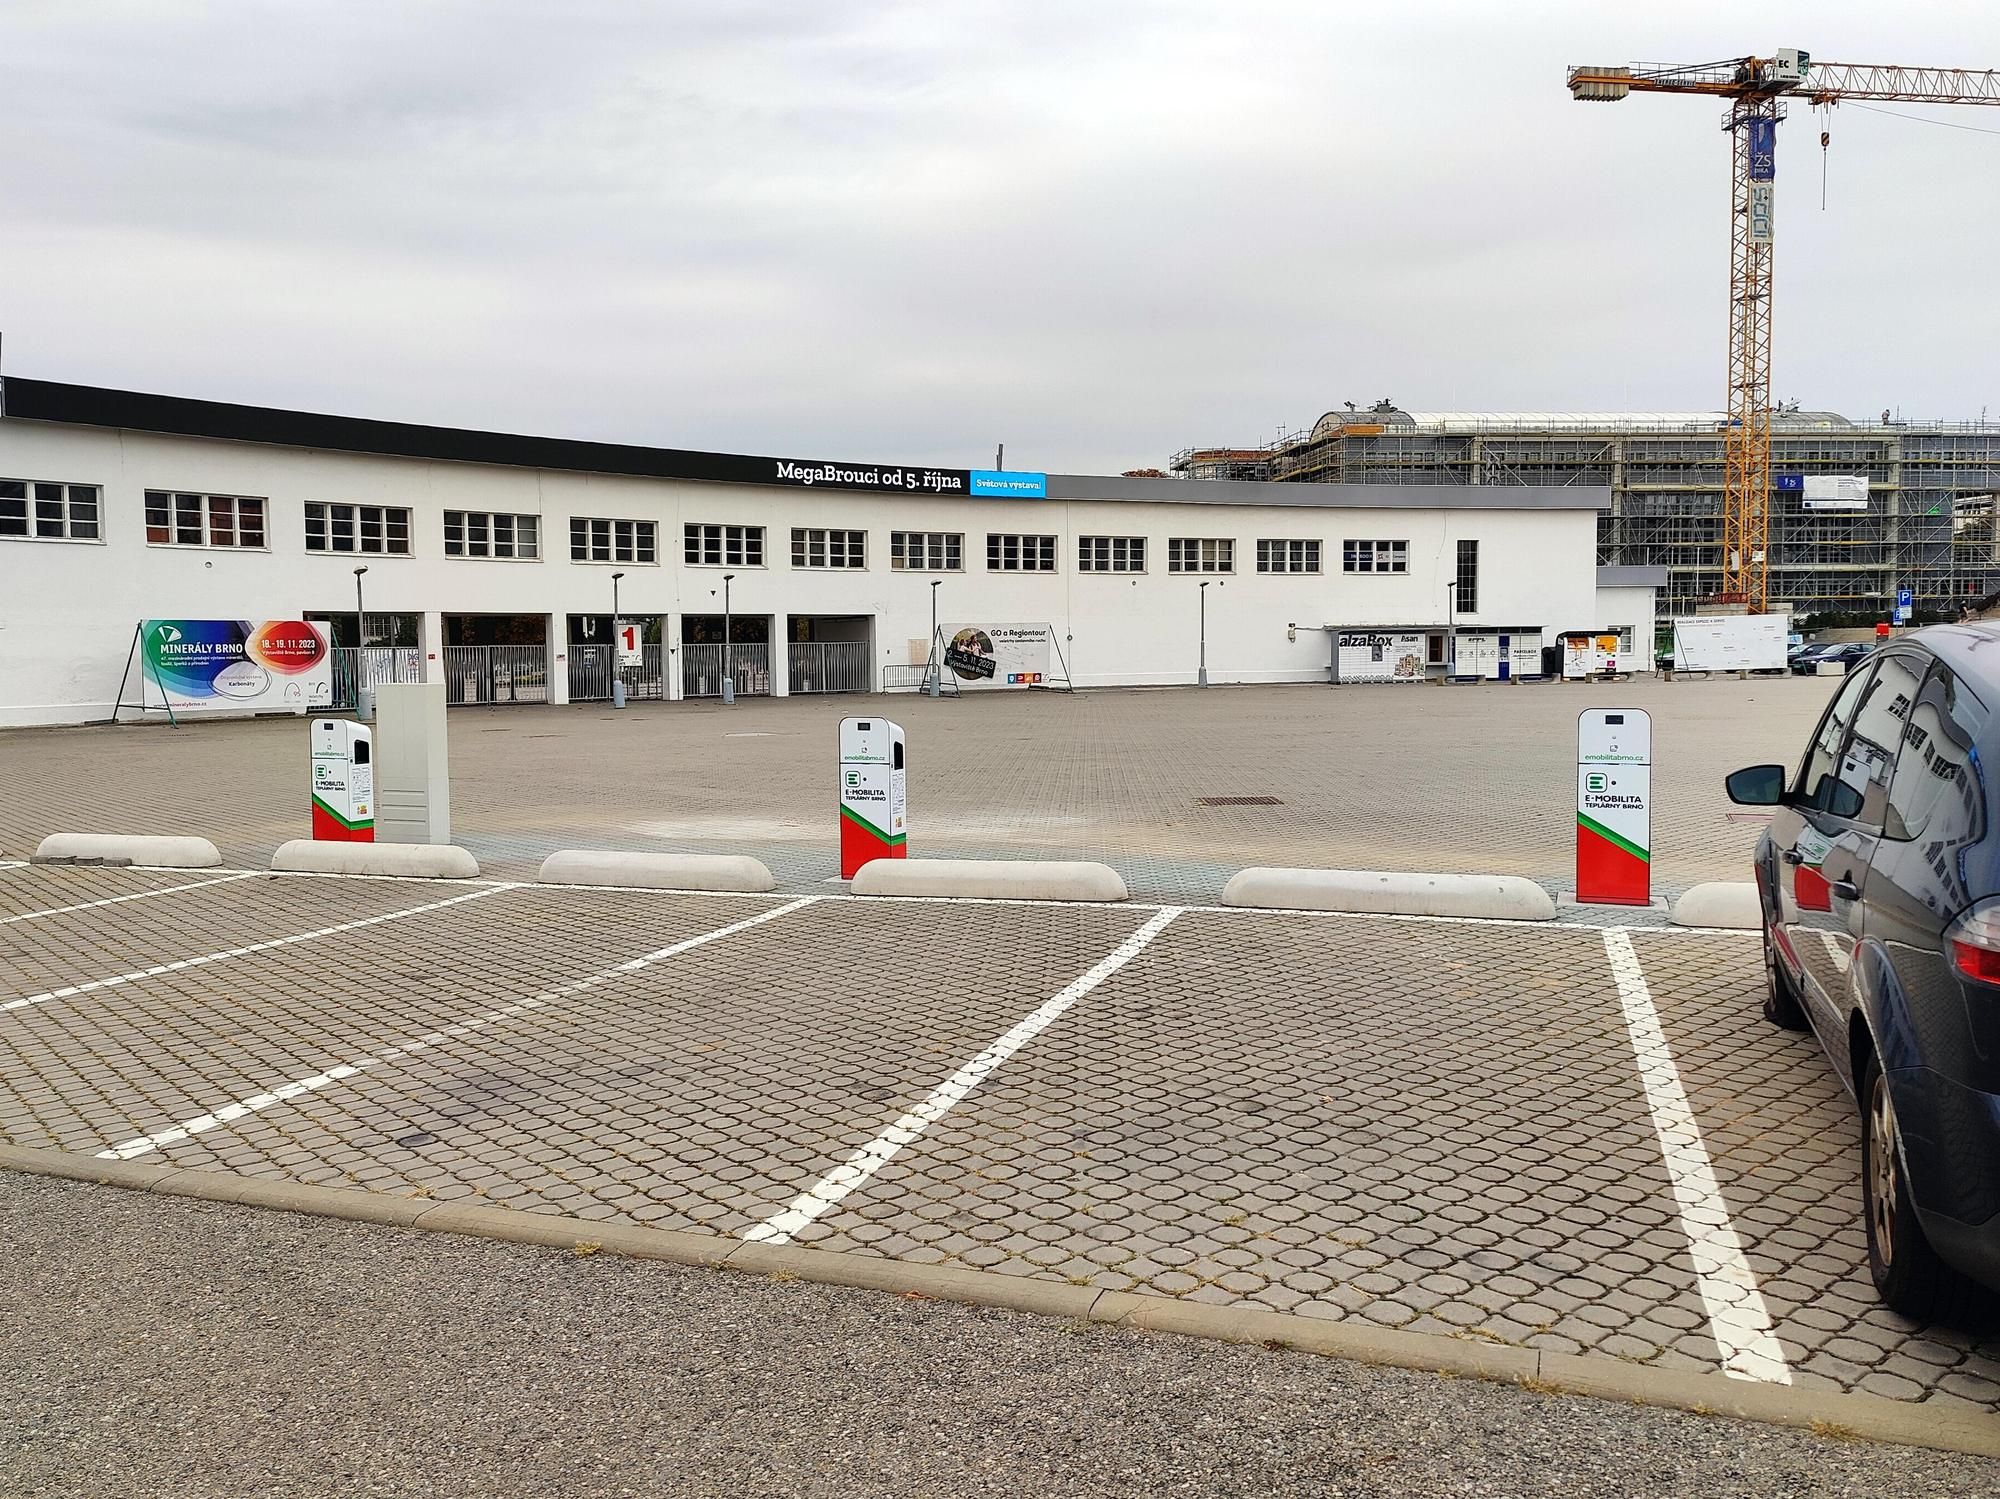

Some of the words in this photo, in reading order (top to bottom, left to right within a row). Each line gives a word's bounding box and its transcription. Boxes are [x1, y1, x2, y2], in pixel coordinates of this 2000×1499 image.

[1778, 60, 1789, 68] EC
[1755, 151, 1771, 167] ŽS
[776, 461, 879, 484] MegaBrouci
[882, 470, 902, 486] od
[906, 473, 920, 489] 5.
[923, 471, 962, 492] října
[976, 479, 1008, 488] Světová
[1901, 592, 1910, 602] P
[622, 627, 634, 650] 1
[1009, 629, 1046, 638] Regiontour
[298, 639, 316, 648] 2023
[1339, 634, 1393, 647] alzaBox
[160, 641, 213, 654] MINERÁLY
[215, 643, 243, 654] BRNO
[978, 658, 994, 670] 2023
[976, 666, 988, 675] Brno
[1585, 795, 1642, 803] E-MOBILITA
